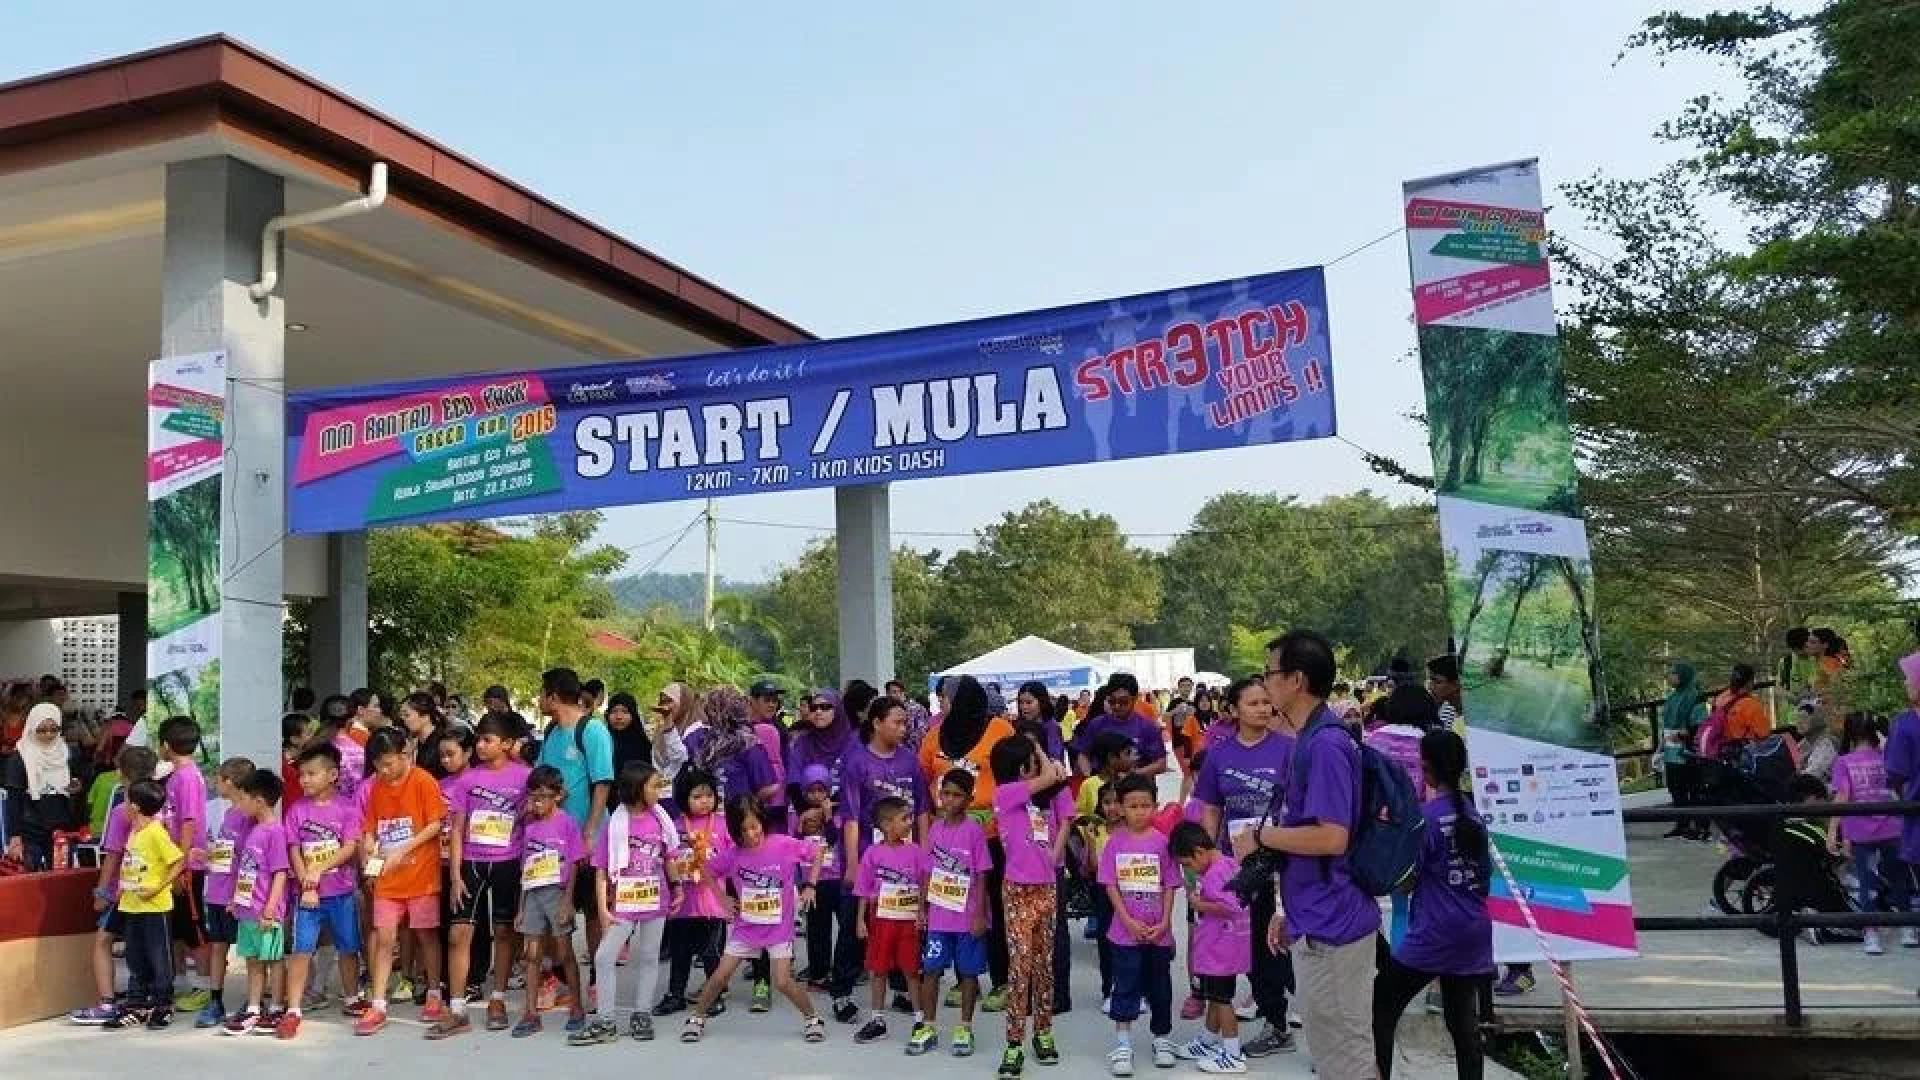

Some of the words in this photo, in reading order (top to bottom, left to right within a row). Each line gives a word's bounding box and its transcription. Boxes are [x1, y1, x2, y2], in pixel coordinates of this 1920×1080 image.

[747, 363, 768, 382] do
[1076, 300, 1308, 402] STR3TCH
[1217, 352, 1287, 396] YOUR
[320, 421, 355, 457] MM
[364, 403, 433, 444] RANTAU
[440, 393, 476, 424] ECO
[511, 403, 556, 441] 2015
[574, 397, 792, 478] START
[811, 388, 852, 454] /
[872, 366, 1069, 448] MULA
[1209, 378, 1299, 428] LIMITS
[686, 470, 731, 491] 12KM
[751, 466, 789, 486] 7KM
[811, 459, 848, 480] 1KM
[853, 453, 893, 476] KIDS
[899, 449, 945, 472] DASH
